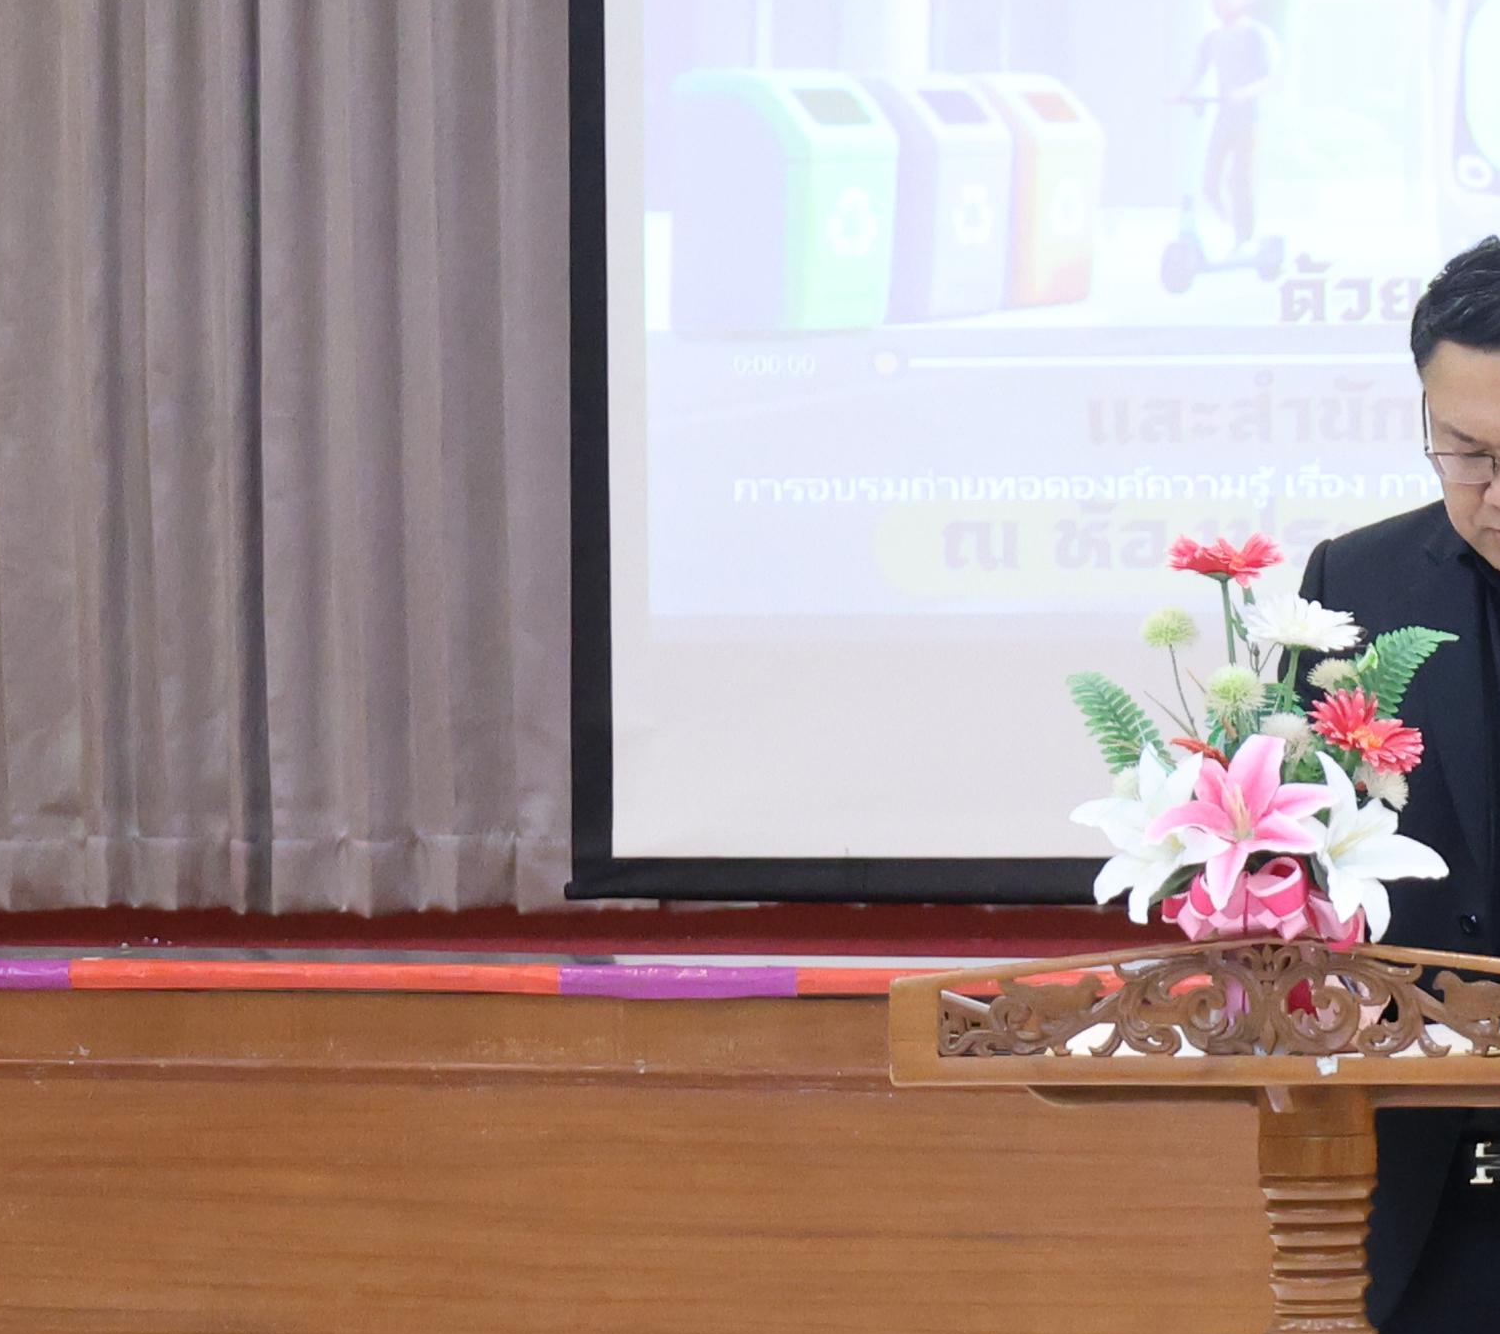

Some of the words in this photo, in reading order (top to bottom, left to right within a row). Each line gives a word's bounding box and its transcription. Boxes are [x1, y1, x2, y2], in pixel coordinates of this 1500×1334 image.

[732, 465, 1271, 509] การอบรมถ่ายทอดองค์ความรู้
[1284, 460, 1366, 500] เรื่อง
[941, 517, 1022, 571] ณ
